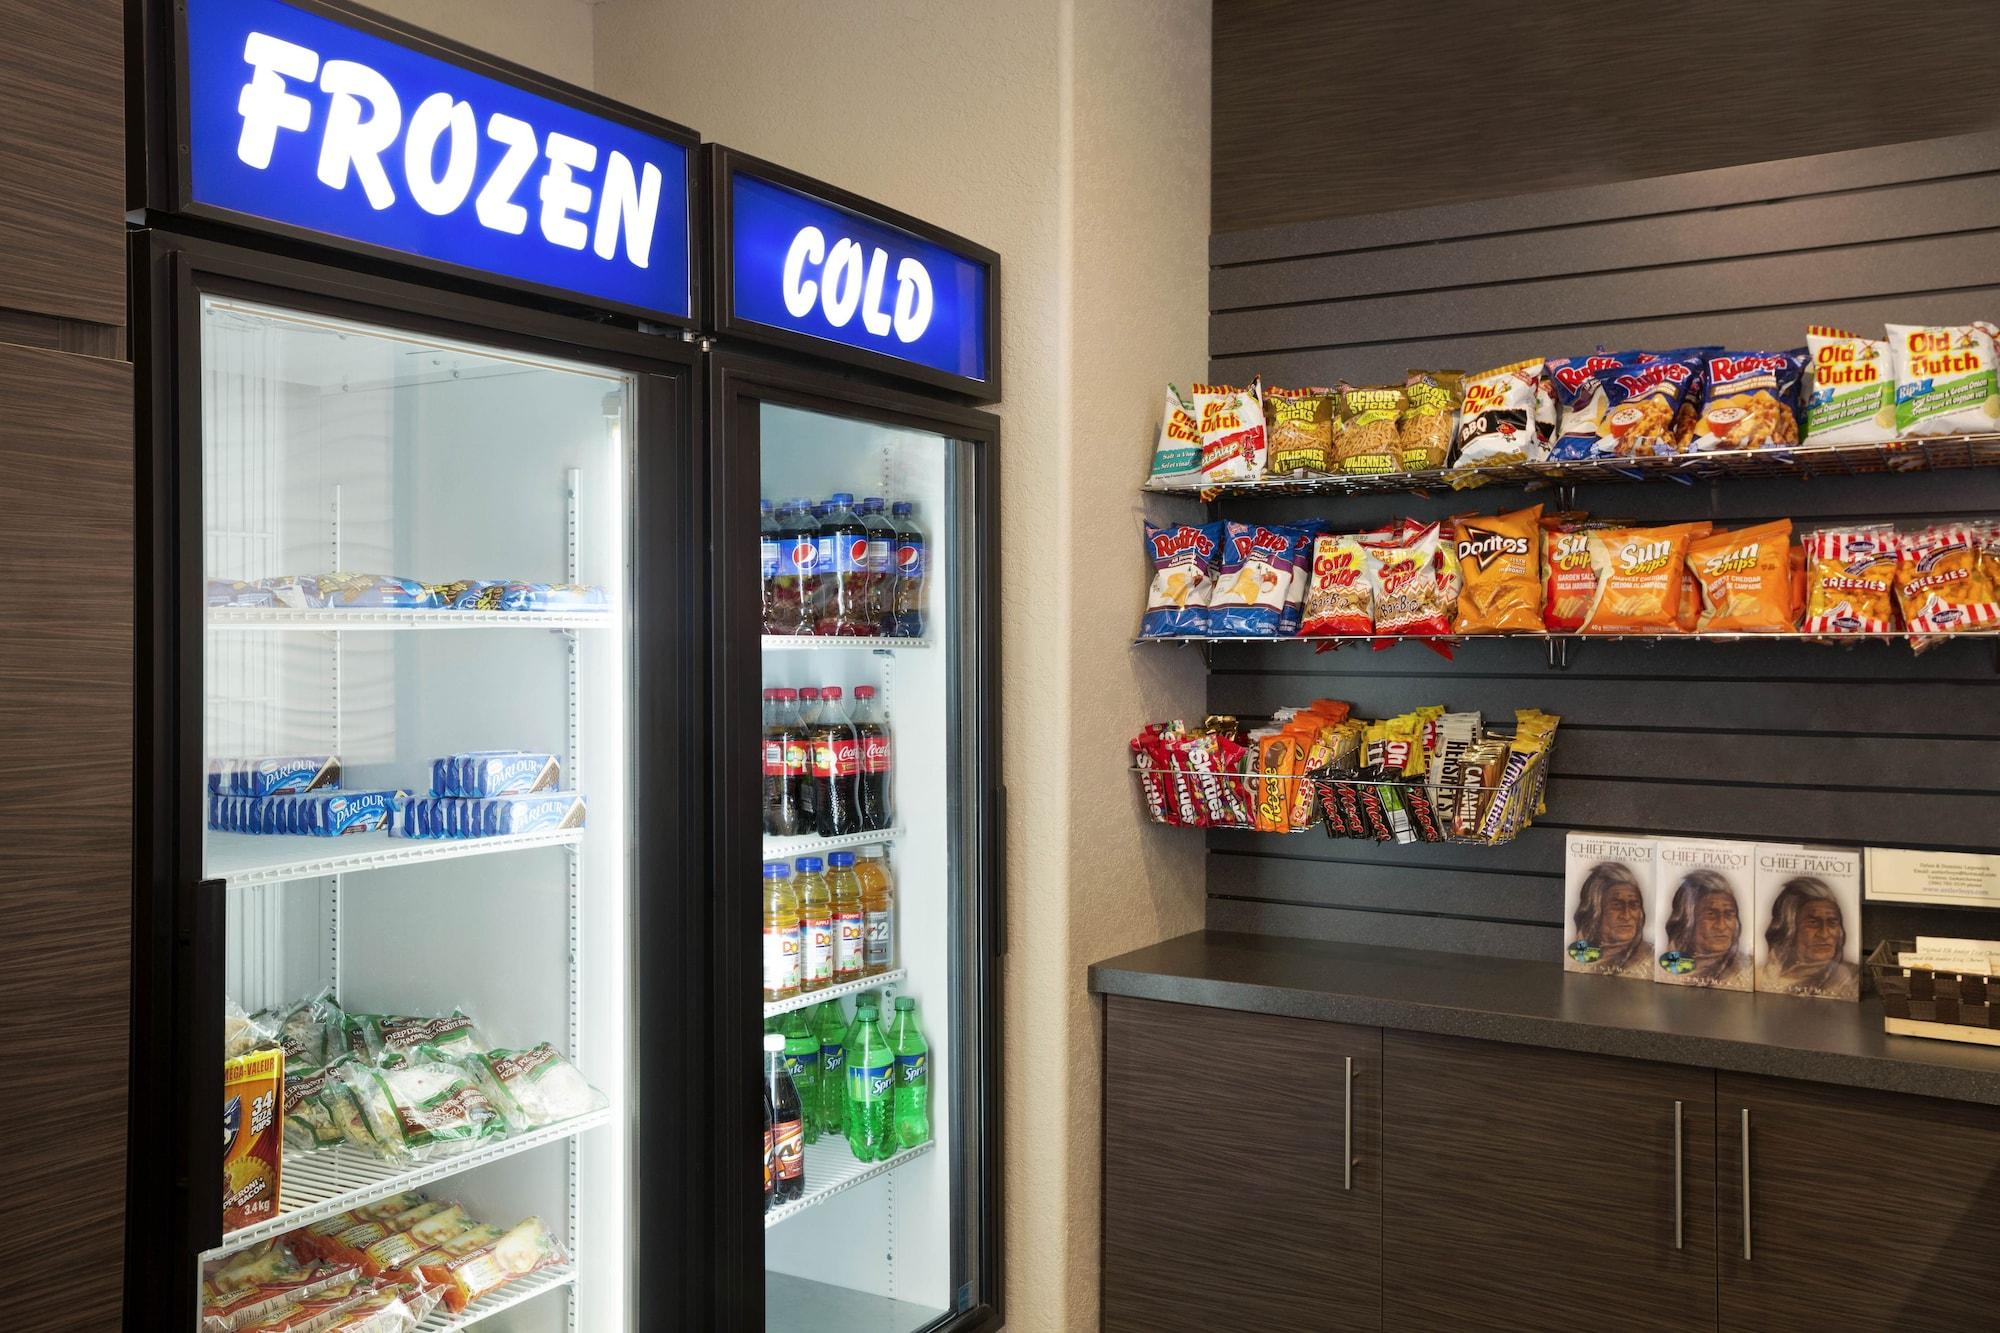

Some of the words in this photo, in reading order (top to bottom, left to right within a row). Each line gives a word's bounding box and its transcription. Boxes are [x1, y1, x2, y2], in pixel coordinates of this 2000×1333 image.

[237, 30, 664, 270] FROZEN
[781, 224, 934, 345] COLD
[1818, 343, 1855, 364] Old
[1909, 331, 1950, 353] Old
[1709, 357, 1788, 384] Ruffles
[1816, 362, 1877, 385] Dutch
[1910, 351, 1979, 377] Dutch
[1468, 385, 1496, 400] Old
[1614, 363, 1691, 398] Ruffles
[1969, 379, 1988, 390] Onion
[1346, 390, 1402, 402] HICKORY
[1350, 402, 1397, 415] STICKS
[1462, 417, 1488, 441] BBQ
[1276, 449, 1324, 462] JULIENNES
[1344, 455, 1392, 468] JULIENNES
[1152, 526, 1215, 559] Ruffles
[1234, 527, 1288, 562] Rffles
[1459, 534, 1528, 560] Doritos
[1553, 535, 1588, 561] Su
[1619, 539, 1671, 571] Sun
[1314, 552, 1353, 576] Corn
[1560, 551, 1591, 571] Chip
[1625, 555, 1669, 576] Chips
[1703, 543, 1760, 575] Sun
[1711, 556, 1758, 576] Chips
[1903, 568, 1968, 597] CHEEZIES
[1387, 742, 1409, 767] Oh
[265, 760, 316, 791] PARLOUR
[493, 759, 537, 786] PARLOUR
[1188, 748, 1223, 820] Skittles
[1136, 752, 1165, 823] Skittles
[1260, 767, 1282, 823] Reese
[1460, 766, 1483, 831] CARAMILK
[336, 795, 385, 829] PARLOUR
[1315, 782, 1345, 832] Mars
[1335, 782, 1364, 833] Mars
[1360, 791, 1391, 841] Mars
[1407, 792, 1438, 841] Mars
[1571, 842, 1607, 855] CHIEF
[1609, 845, 1653, 858] PIAPOT
[1662, 850, 1698, 862] CHIEF
[1703, 852, 1749, 867] PIAPOT
[1761, 856, 1800, 869] CHIEF
[1804, 858, 1853, 873] PIAPOT
[252, 1090, 273, 1117] 34
[251, 1108, 272, 1126] PIZZA
[251, 1117, 272, 1136] POPS
[237, 1181, 266, 1206] BACON
[244, 1203, 258, 1216] 3.4
[258, 1199, 270, 1212] kg
